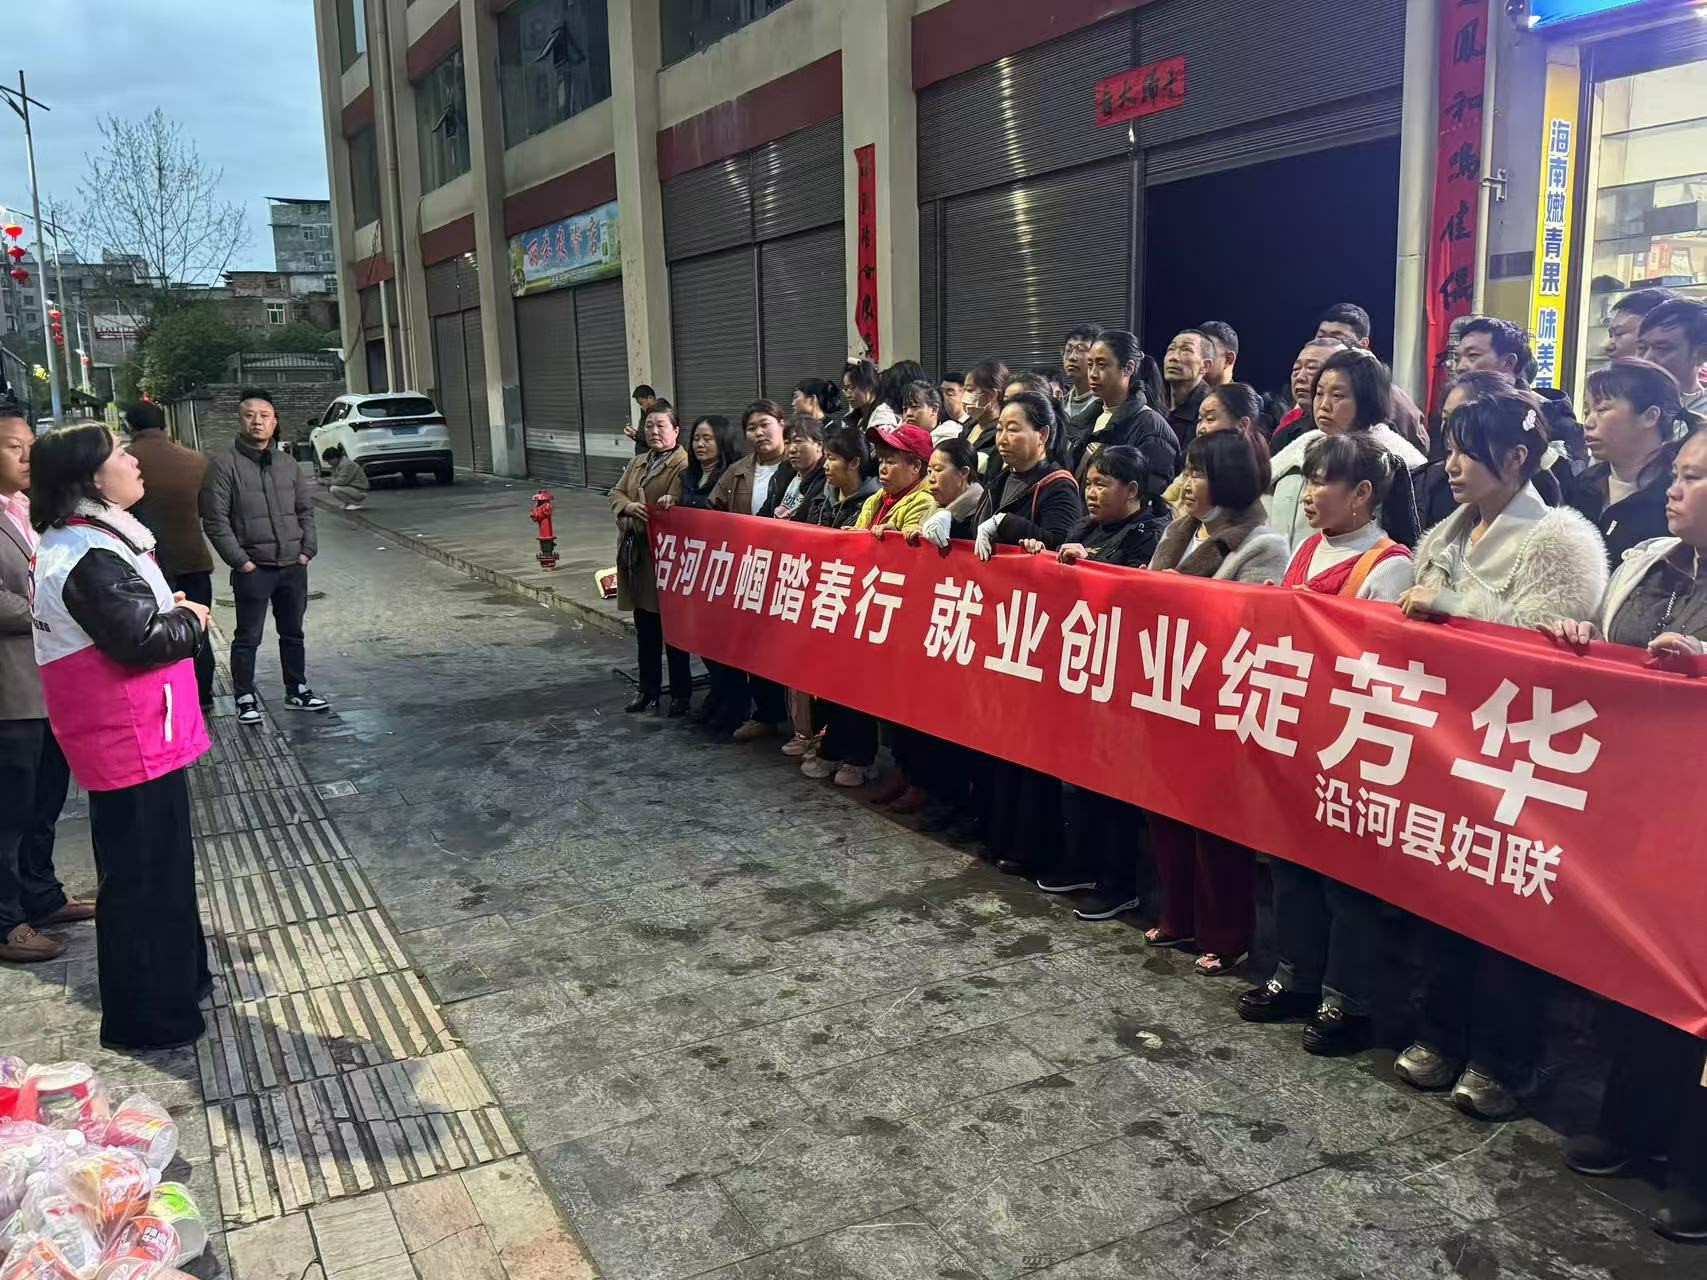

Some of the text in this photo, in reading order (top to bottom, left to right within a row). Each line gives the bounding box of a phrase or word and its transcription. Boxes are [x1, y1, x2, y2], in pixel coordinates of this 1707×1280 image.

[1542, 119, 1571, 292] 海南嫩青果
[654, 531, 1602, 829] 沿河巾帼踏春行 就业创业绽芳华
[1313, 772, 1564, 905] 沿河县妇联
